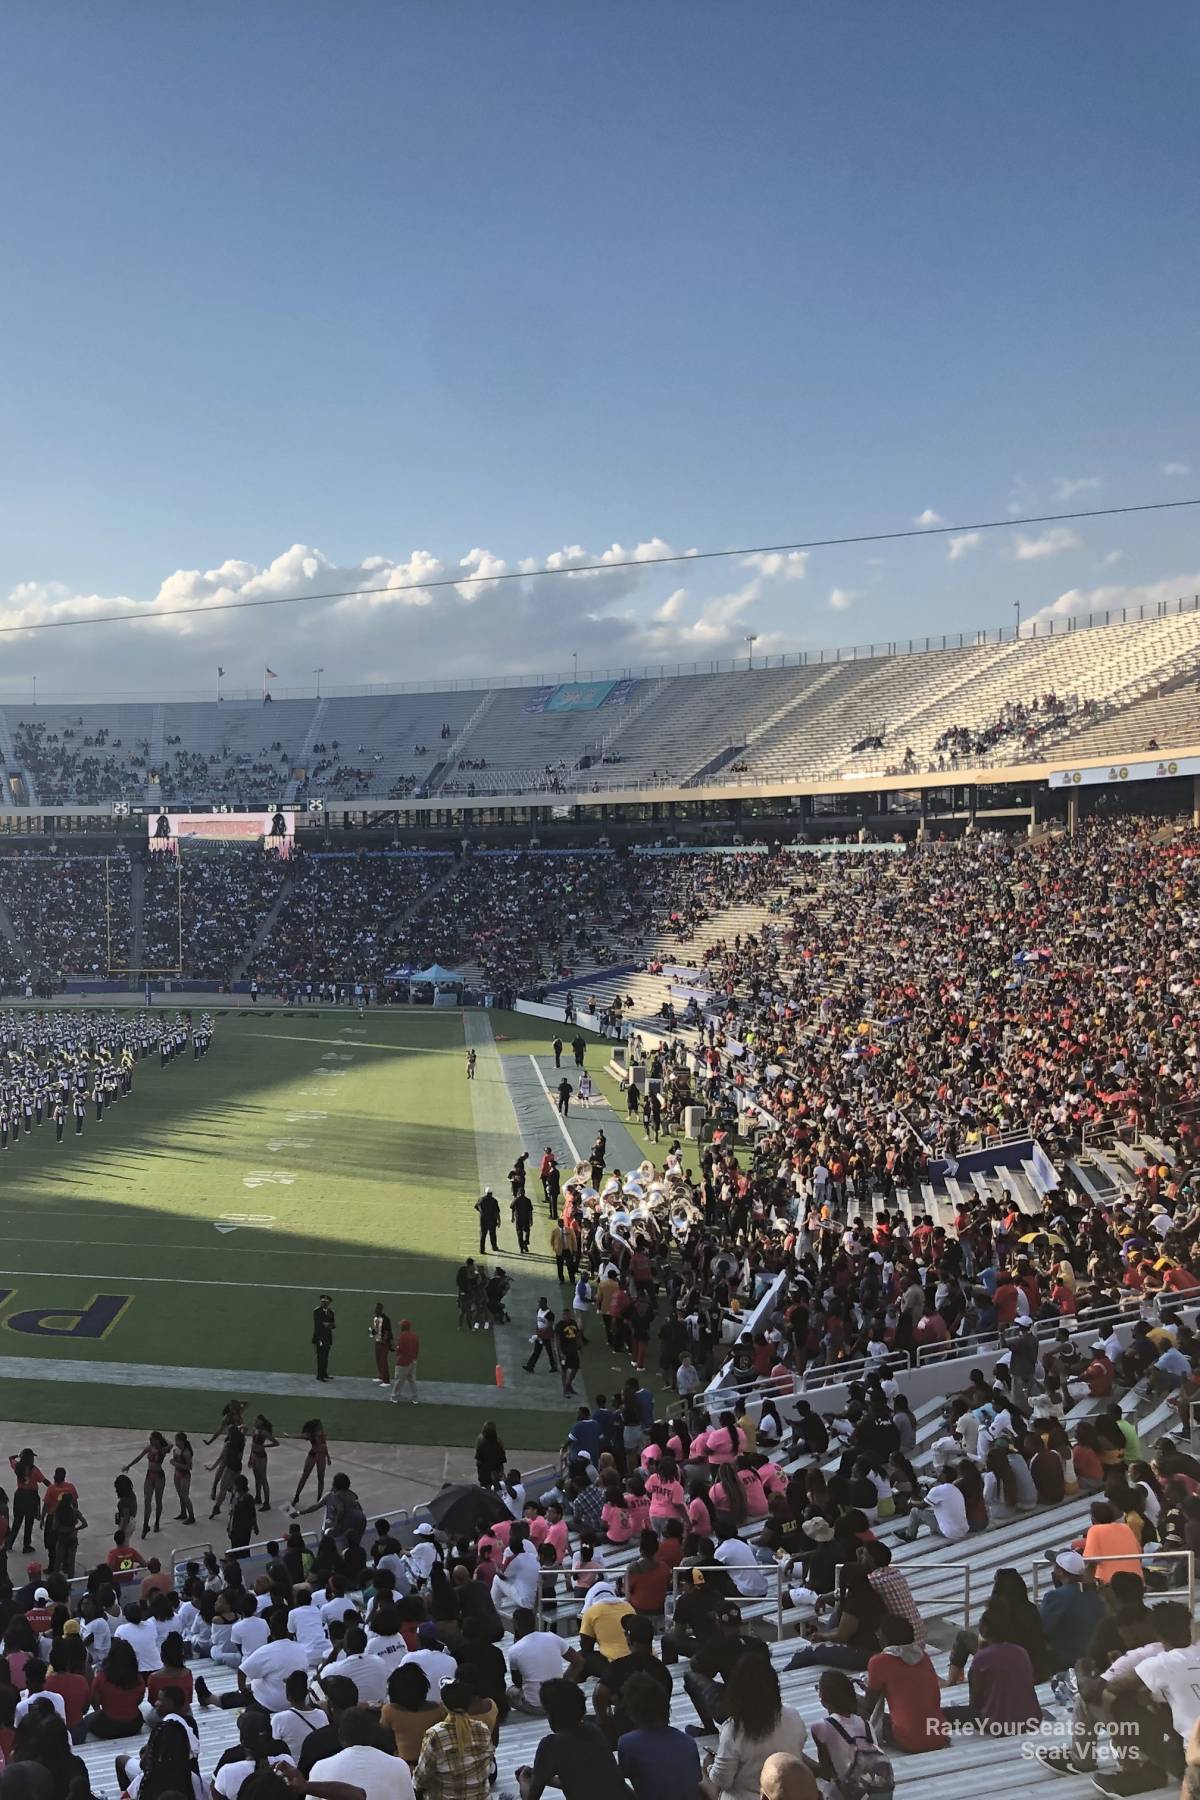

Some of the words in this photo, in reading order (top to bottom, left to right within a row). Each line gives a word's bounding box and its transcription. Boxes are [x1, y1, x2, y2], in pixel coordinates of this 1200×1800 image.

[114, 803, 128, 813] 25
[310, 800, 323, 811] 25
[652, 1485, 672, 1497] STAFF
